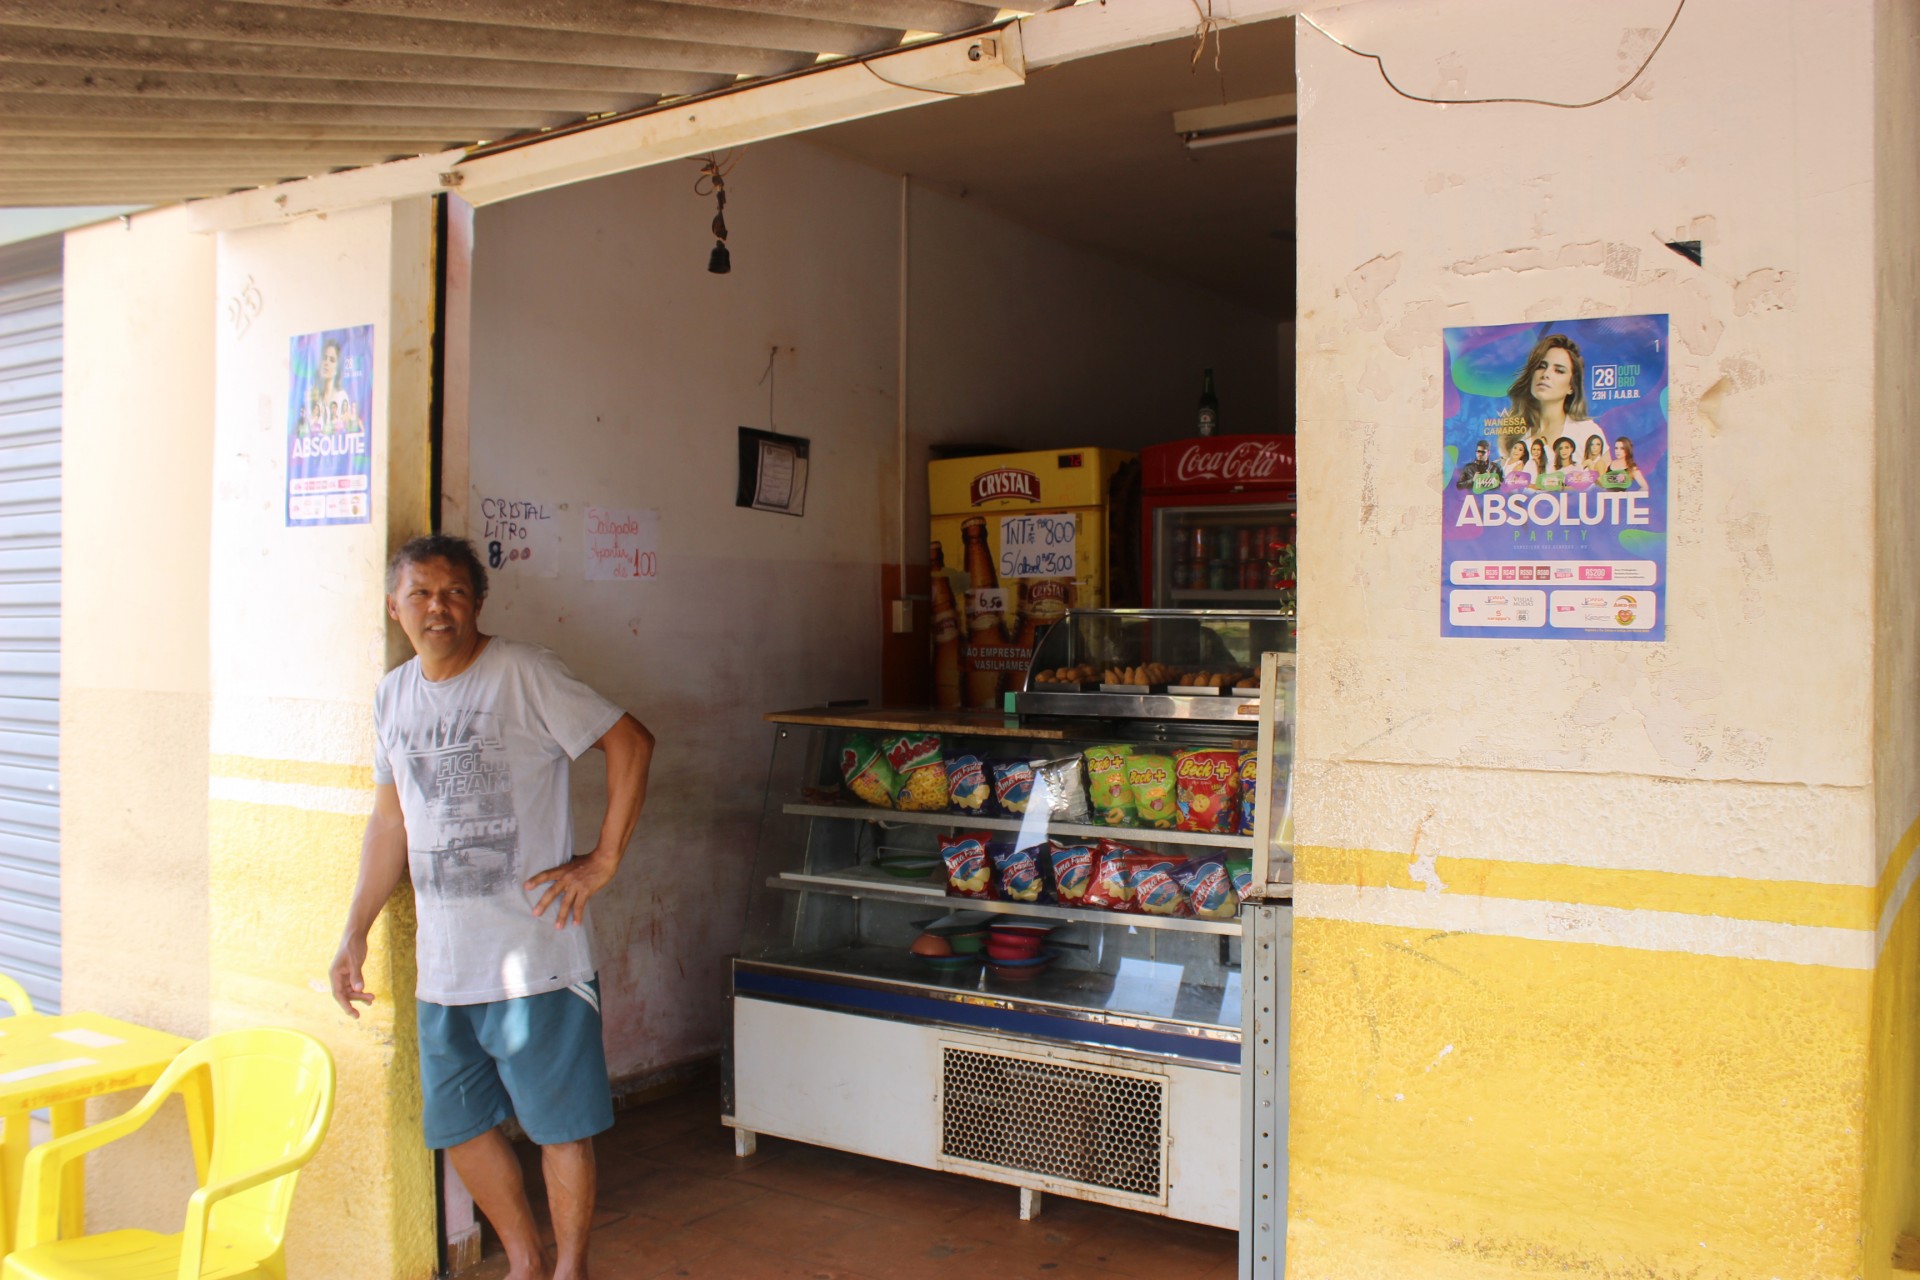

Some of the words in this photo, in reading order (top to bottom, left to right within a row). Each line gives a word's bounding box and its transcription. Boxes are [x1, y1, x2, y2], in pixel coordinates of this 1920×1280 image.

[1594, 367, 1615, 388] 28
[1618, 364, 1641, 376] OUTU
[1618, 376, 1636, 388] BRO
[1483, 417, 1527, 427] WANESSA
[1483, 426, 1528, 436] CAMARGO
[292, 432, 365, 460] ABSOLUTE
[1178, 441, 1281, 482] Coca-Cola
[978, 471, 1033, 498] CRYSTAL
[1455, 490, 1650, 527] ABSOLUTE
[1001, 518, 1032, 545] TNT
[1513, 529, 1589, 542] PARTY
[974, 659, 1030, 671] VASILHAMES
[437, 752, 511, 778] FIGHT
[1241, 761, 1257, 778] Be
[436, 772, 512, 799] TEAM
[441, 816, 517, 838] MATCH
